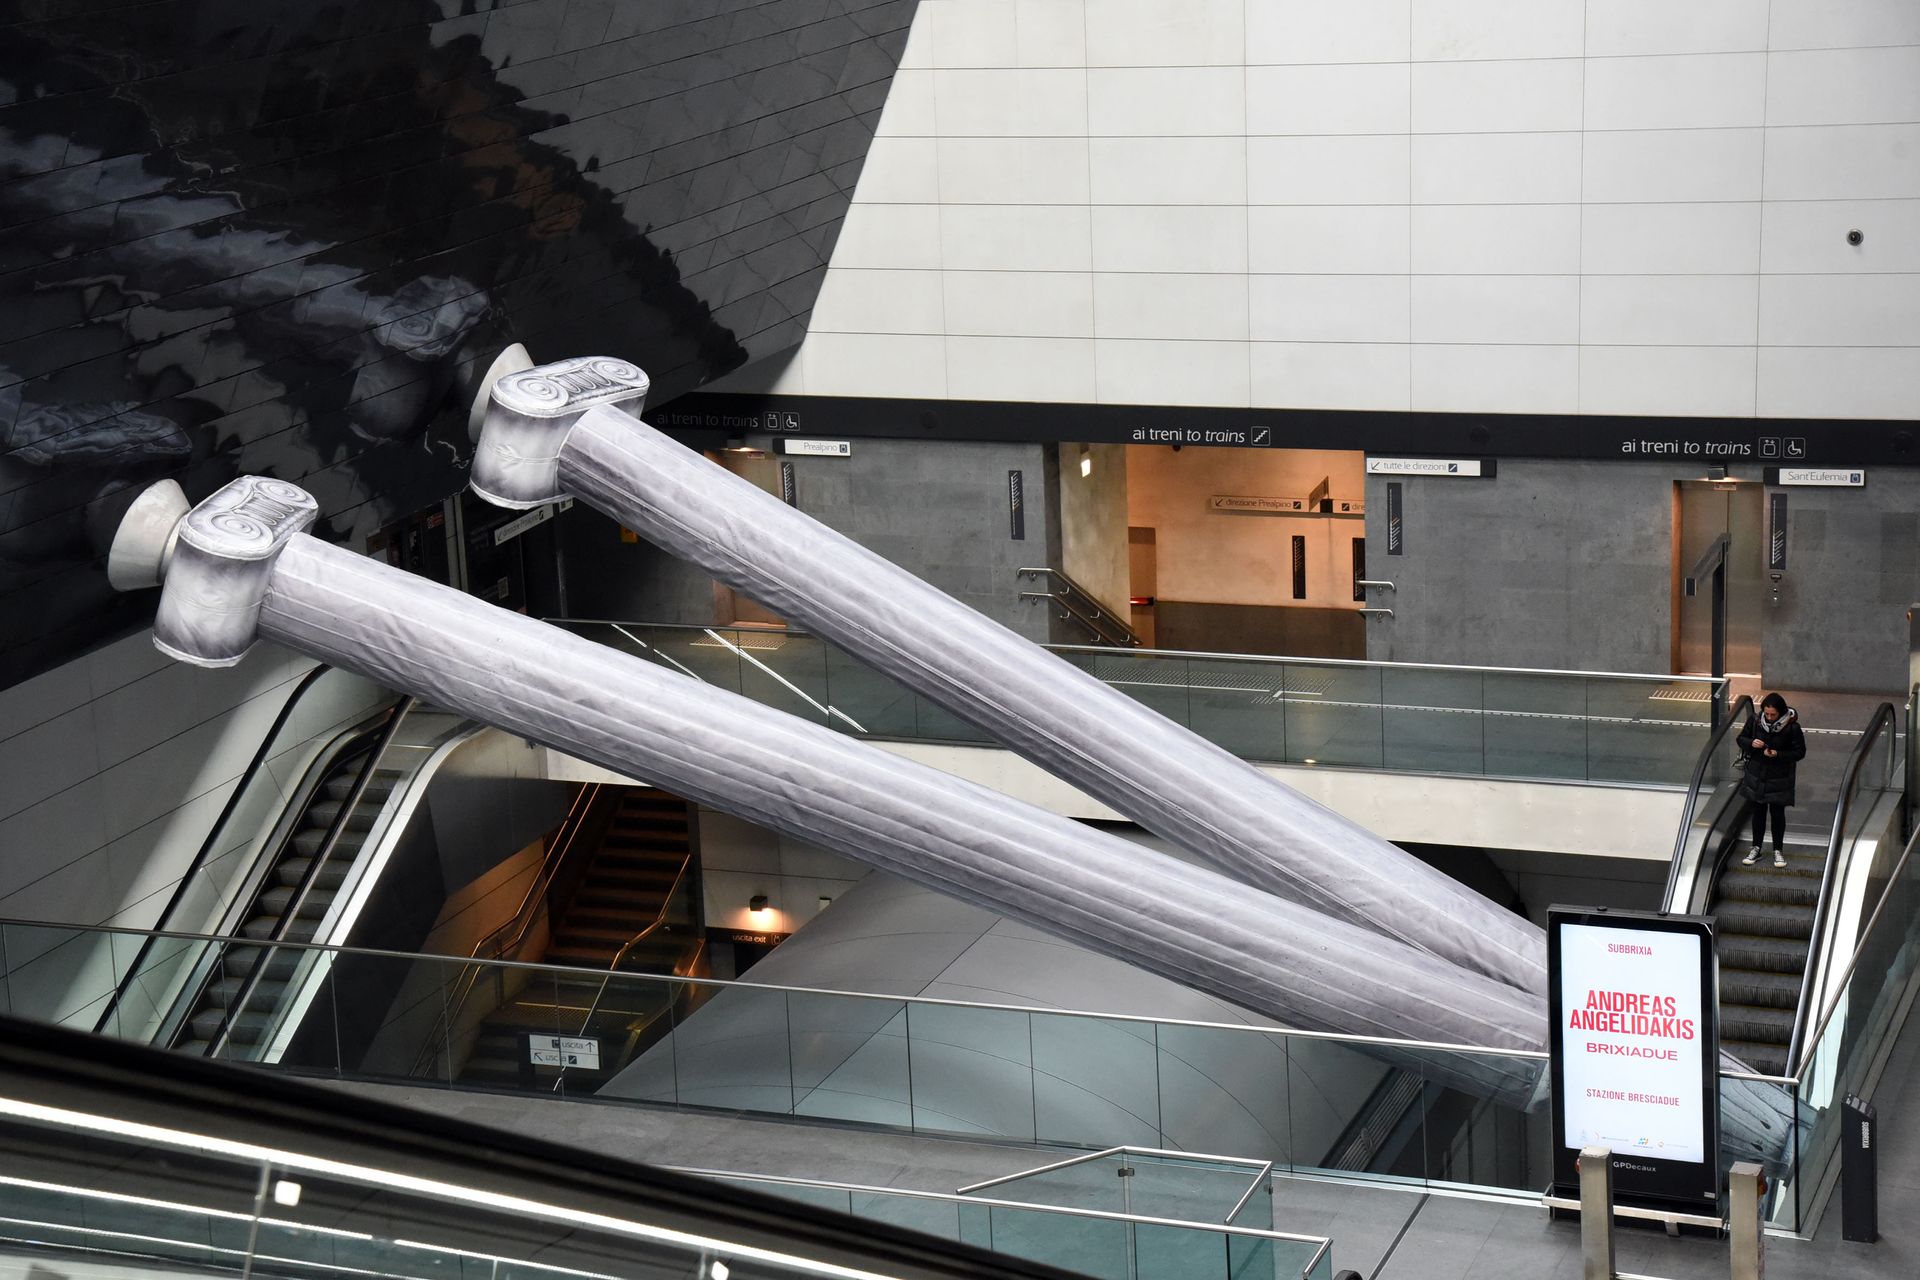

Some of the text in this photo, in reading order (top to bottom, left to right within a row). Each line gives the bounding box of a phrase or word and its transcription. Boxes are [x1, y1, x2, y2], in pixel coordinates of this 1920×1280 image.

[657, 411, 759, 428] ai treni to trains
[1132, 426, 1245, 443] ai treni to trains
[803, 441, 838, 453] Prealpino
[1621, 438, 1751, 455] ai treni to trains
[1383, 460, 1447, 471] tutte le direzioni
[1787, 471, 1848, 481] Sant'Eufemia
[1225, 498, 1292, 509] direzione Prealpino
[753, 935, 767, 943] exit
[1608, 943, 1652, 956] SUBBRIXIA
[1586, 989, 1677, 1017] ANDREAS
[1569, 1008, 1694, 1040] ANGELIDAKIS
[561, 1041, 584, 1049] uscita
[1586, 1042, 1678, 1061] BRIXIADUE
[1586, 1088, 1680, 1107] STAZIONE BRESCIADUE
[1612, 1161, 1657, 1173] GPDecaux
